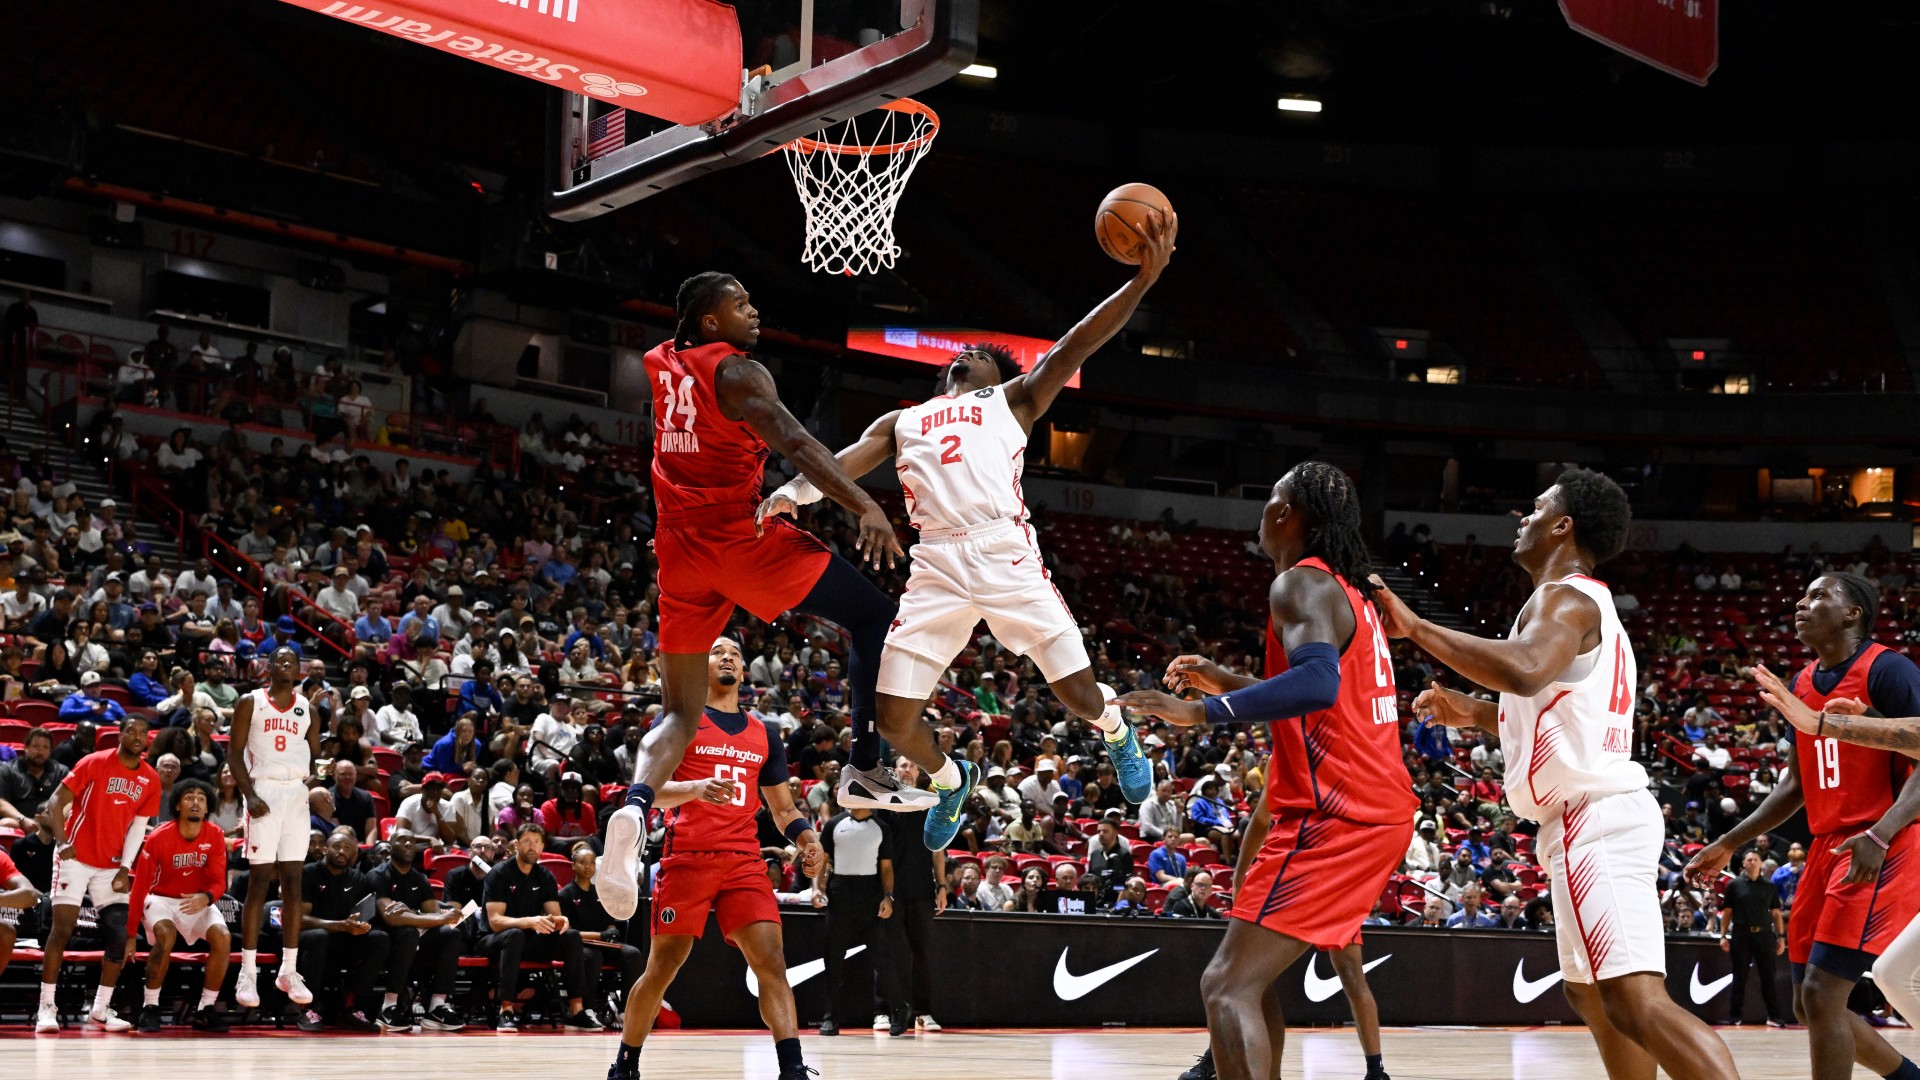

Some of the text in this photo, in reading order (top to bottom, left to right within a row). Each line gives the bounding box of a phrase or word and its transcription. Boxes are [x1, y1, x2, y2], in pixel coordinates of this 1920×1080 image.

[173, 228, 215, 257] 117
[658, 370, 698, 433] 34
[615, 418, 648, 442] 118
[921, 406, 982, 436] BULLS
[940, 435, 962, 465] 2
[1062, 487, 1095, 511] 119
[264, 718, 298, 735] BULLS
[274, 735, 287, 752] 8
[695, 743, 763, 764] washington
[1814, 738, 1840, 790] 19
[106, 777, 142, 802] BULLS
[172, 852, 208, 869] BULLS
